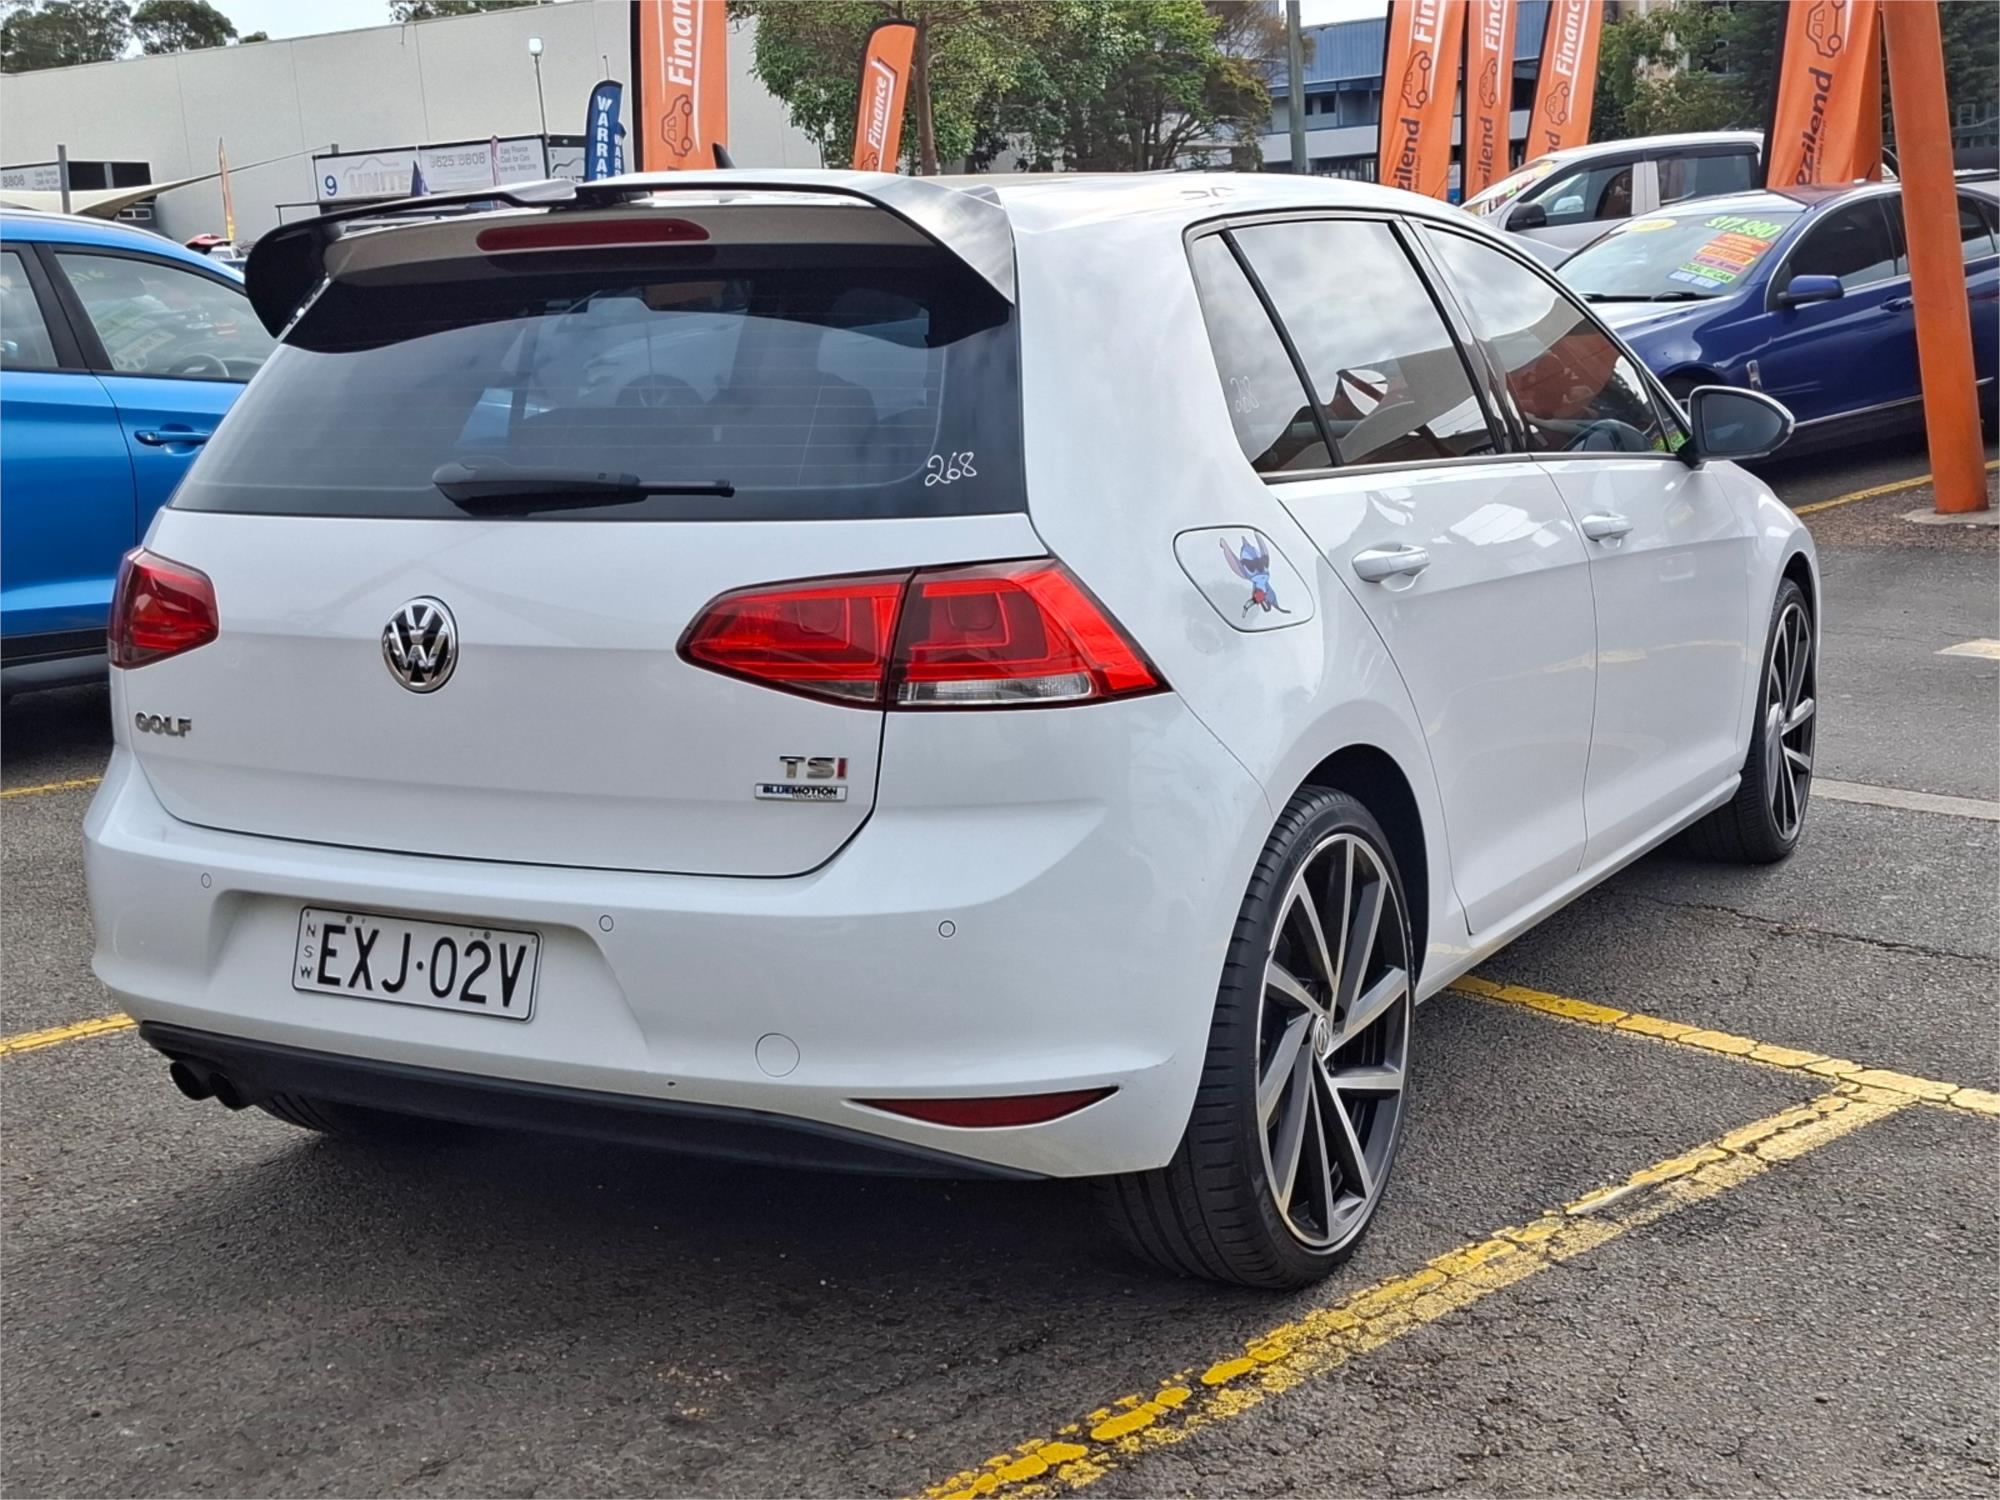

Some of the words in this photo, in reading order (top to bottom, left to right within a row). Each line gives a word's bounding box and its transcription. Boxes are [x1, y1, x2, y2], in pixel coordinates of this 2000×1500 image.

[868, 75, 888, 150] Finance
[325, 175, 338, 196] 9
[1704, 215, 1782, 239] $17,990
[924, 452, 978, 487] 268
[135, 711, 192, 737] GOLF
[779, 755, 848, 780] TSI
[762, 785, 838, 796] BLUEMOTION
